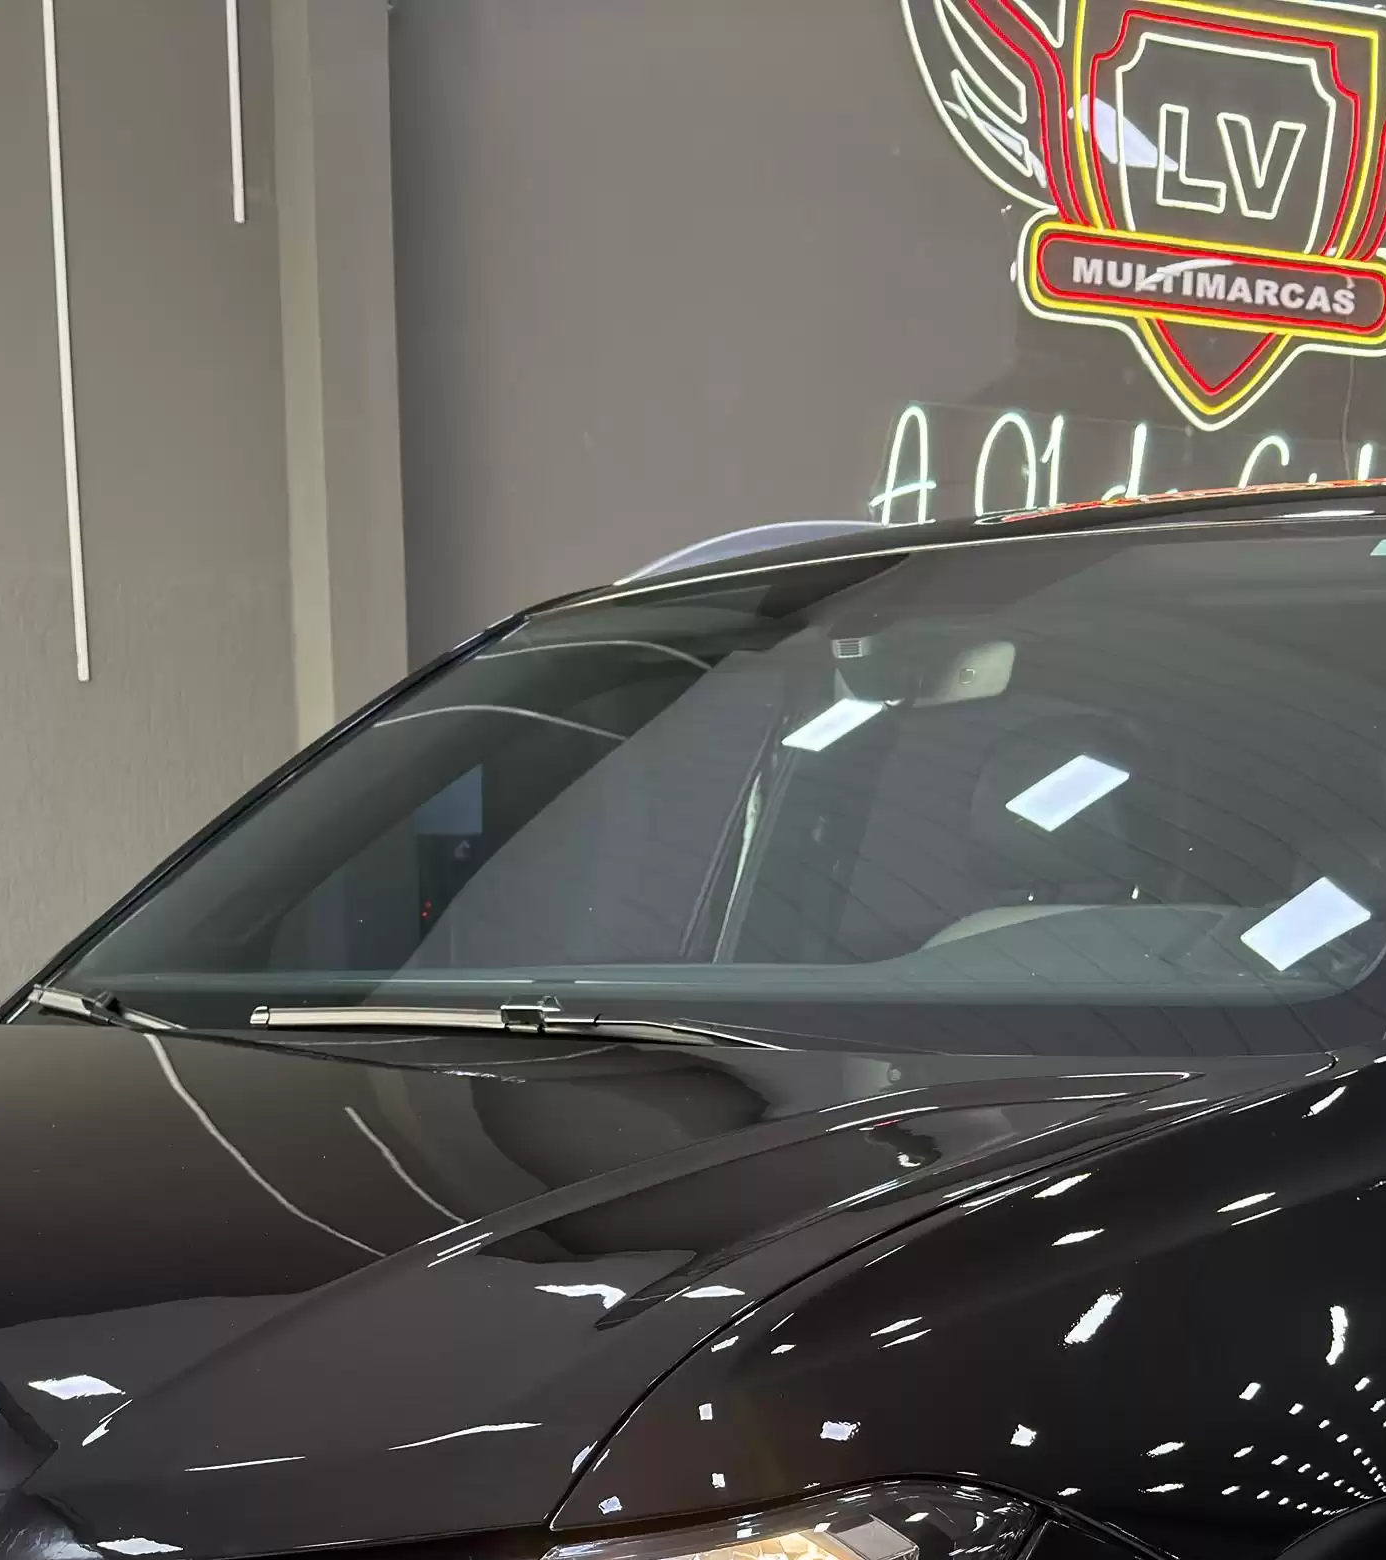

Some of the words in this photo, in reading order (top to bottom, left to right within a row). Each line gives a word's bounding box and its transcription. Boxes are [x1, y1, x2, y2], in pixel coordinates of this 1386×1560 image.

[1156, 102, 1307, 220] LV
[1072, 256, 1356, 315] MULTIMARCAS
[869, 405, 937, 524] A
